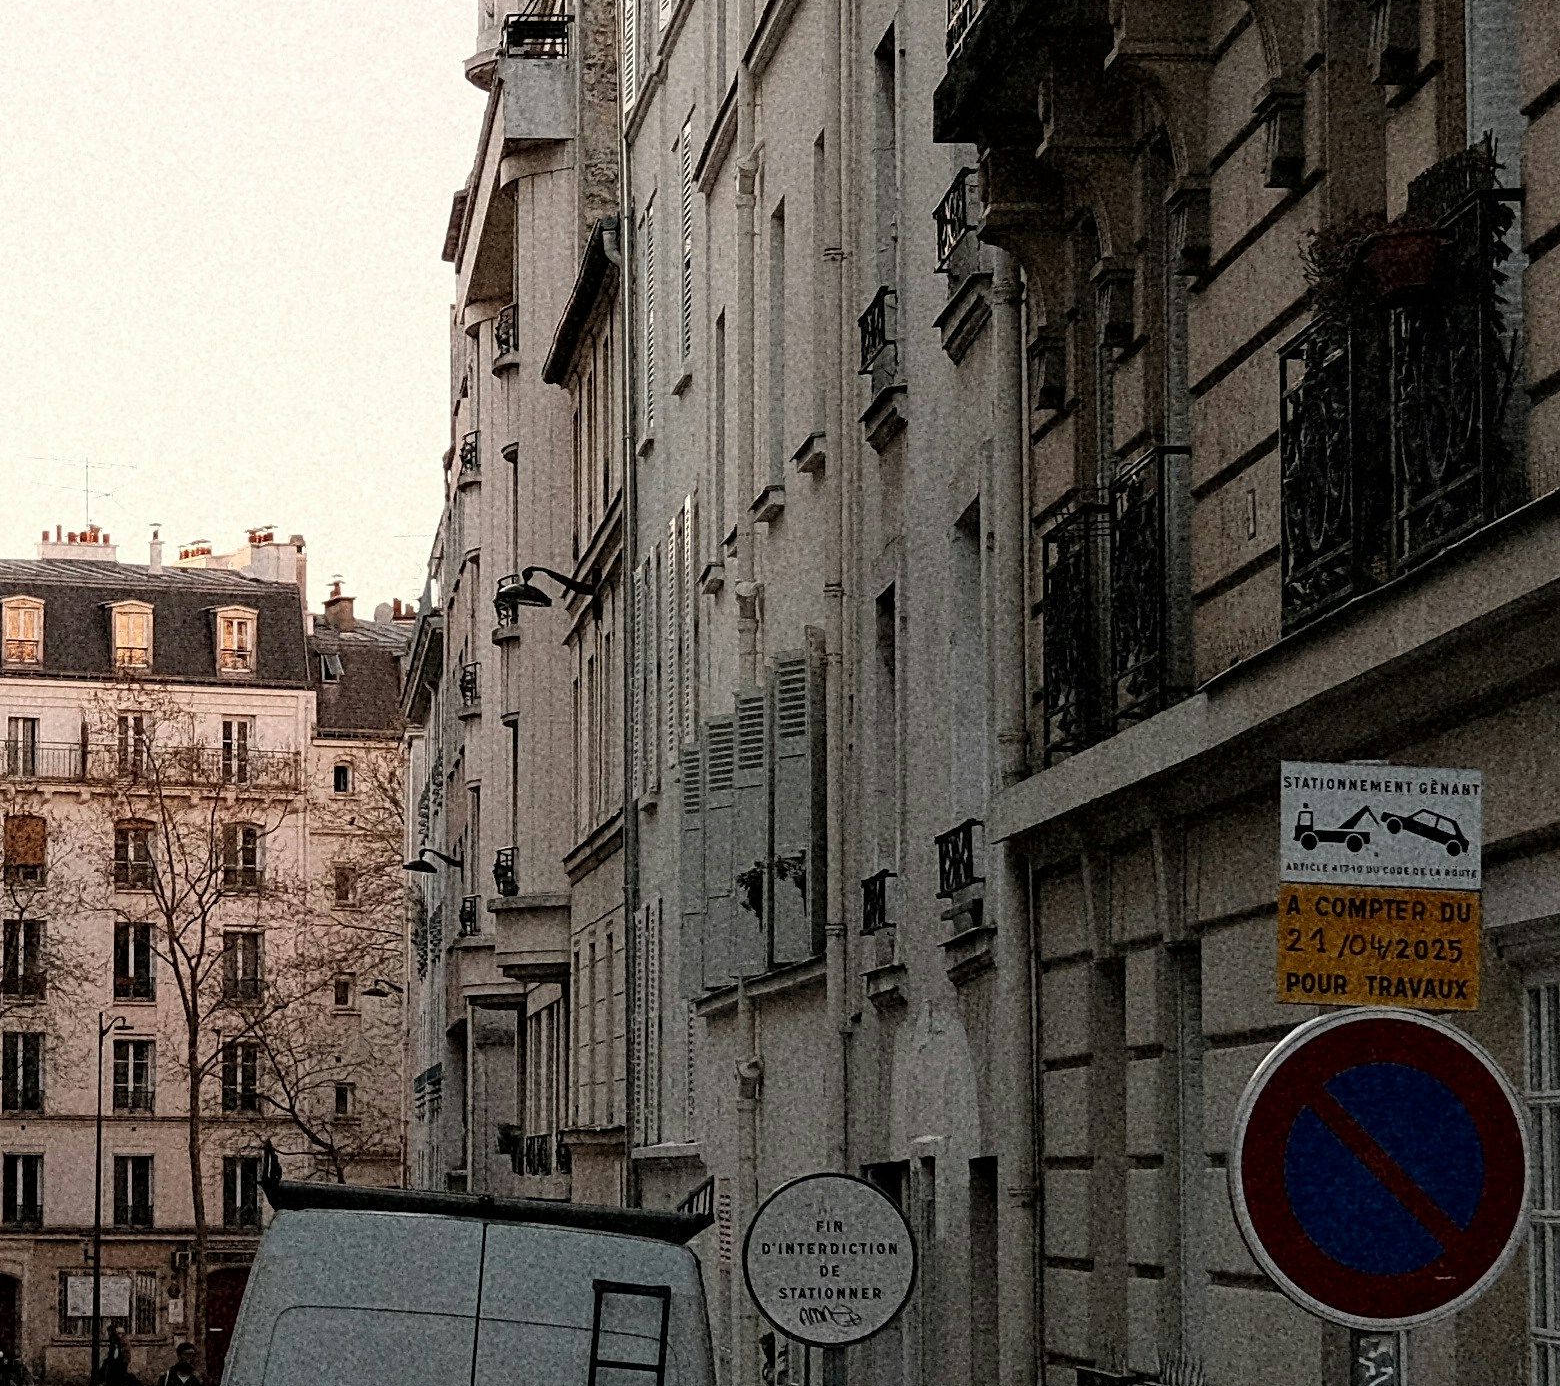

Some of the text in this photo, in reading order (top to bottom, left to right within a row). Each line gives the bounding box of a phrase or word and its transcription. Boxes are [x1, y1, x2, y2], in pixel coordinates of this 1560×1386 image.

[1283, 776, 1413, 793] STATIONNEMENT
[1285, 862, 1328, 872] ARTICLE
[1366, 865, 1380, 874] DU
[1383, 866, 1409, 875] CODE
[1413, 867, 1427, 876] DE
[1429, 867, 1441, 877] LA
[1444, 868, 1477, 878] ROUTE
[1286, 895, 1472, 923] A COMPTER DU
[1286, 972, 1469, 1000] POUR TRAVAUX
[816, 1220, 843, 1233] FIN
[761, 1242, 898, 1255] D'INTERDICTION
[820, 1265, 840, 1278] DE
[778, 1287, 882, 1300] STATIONNER
